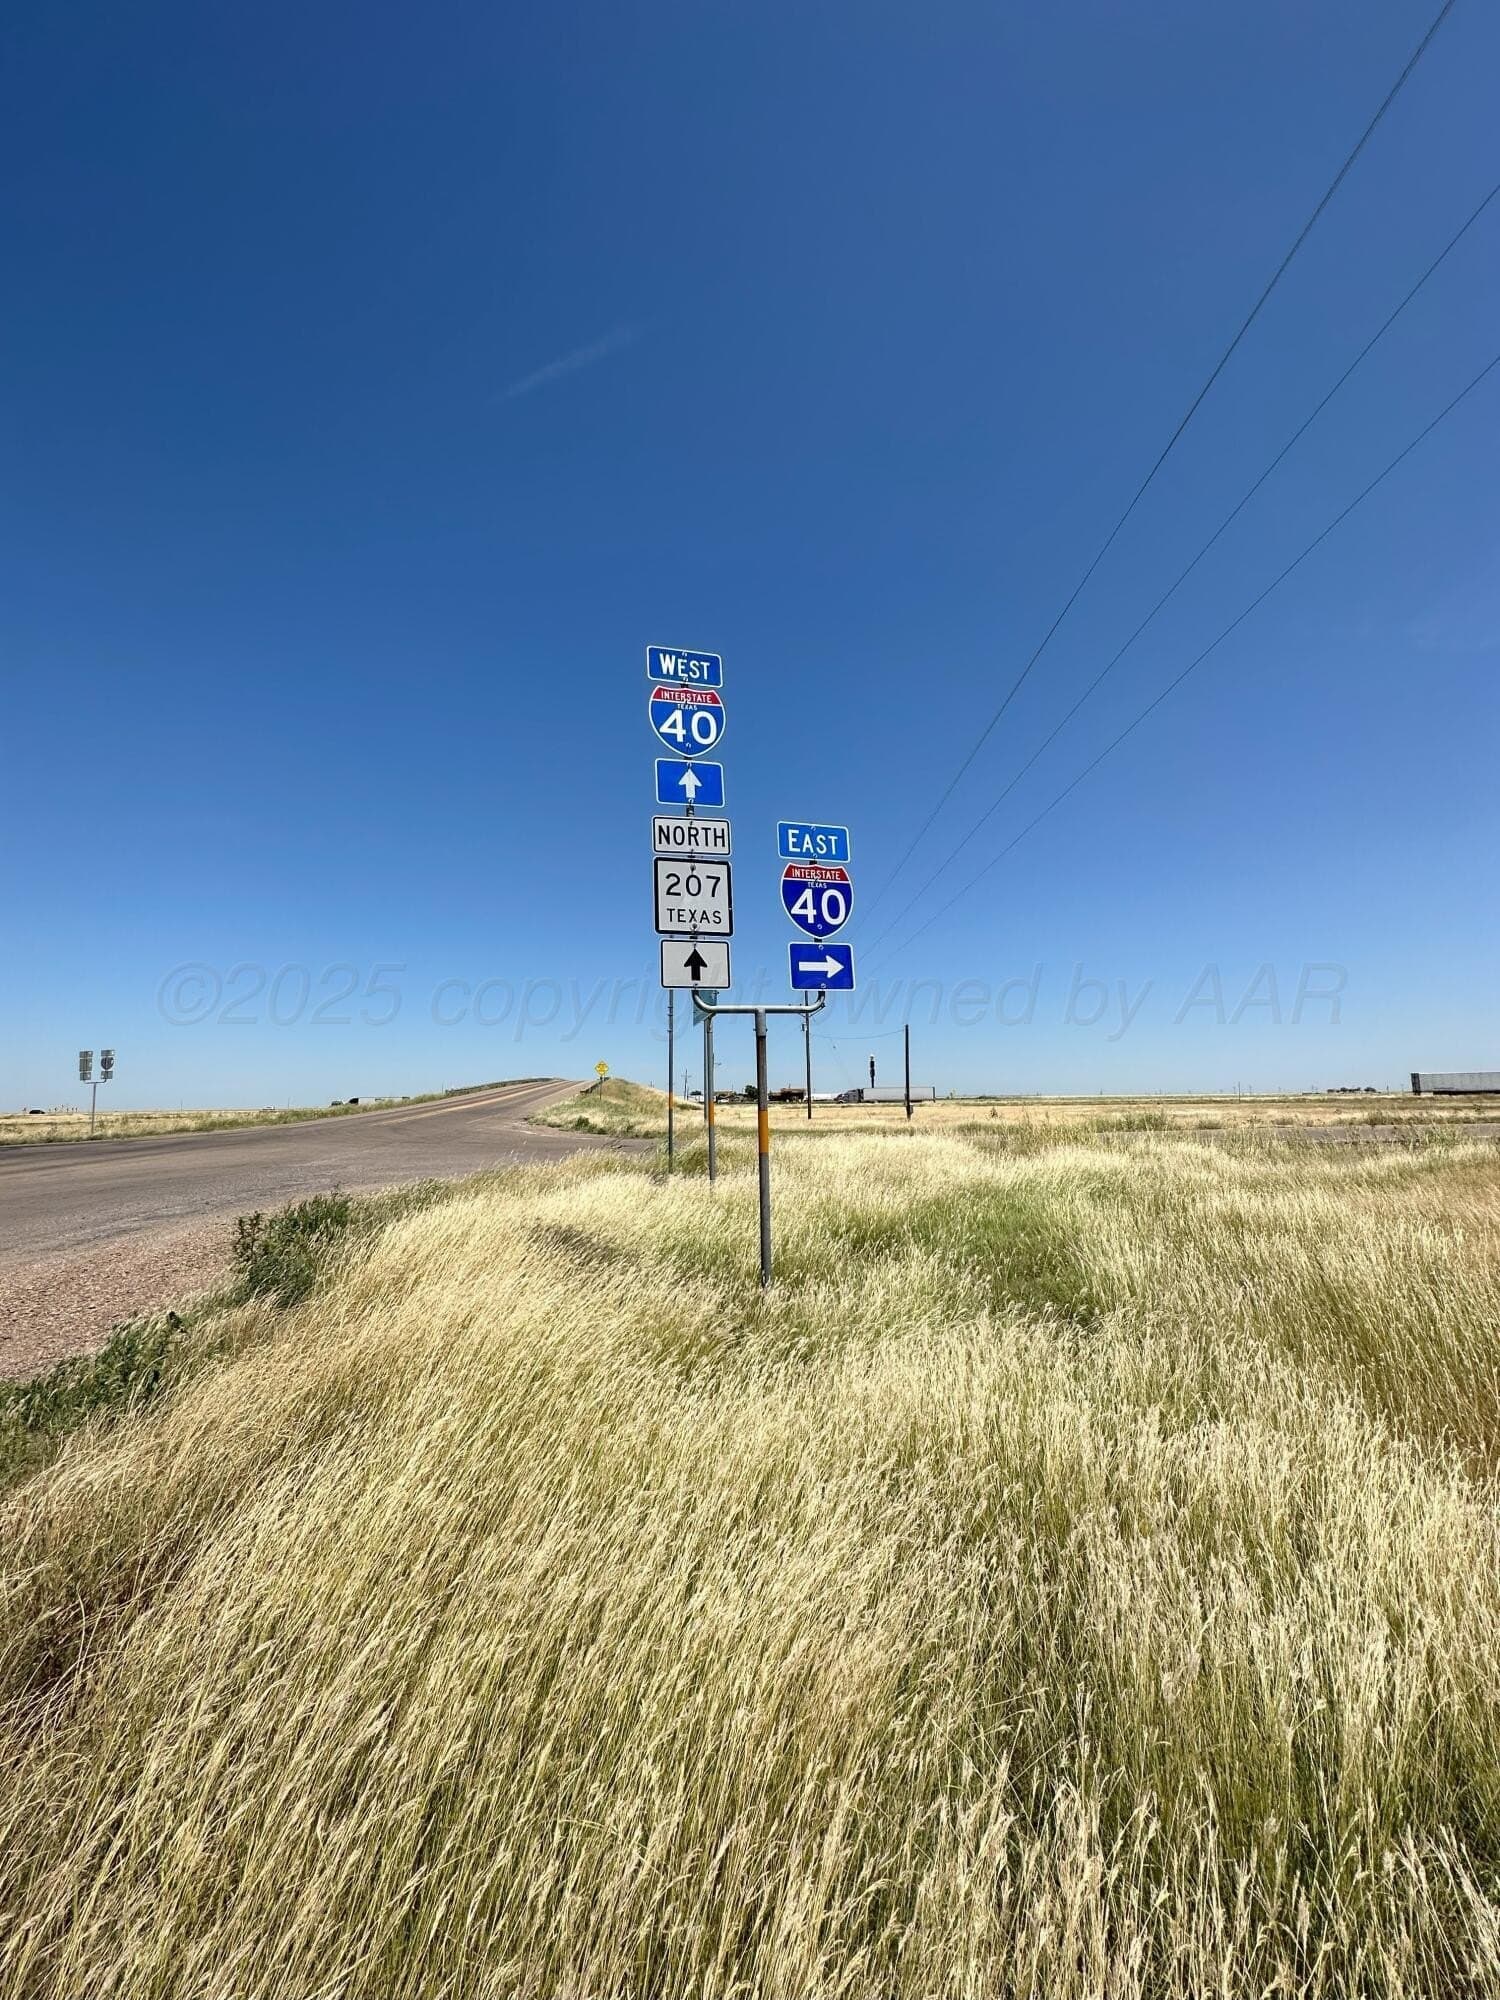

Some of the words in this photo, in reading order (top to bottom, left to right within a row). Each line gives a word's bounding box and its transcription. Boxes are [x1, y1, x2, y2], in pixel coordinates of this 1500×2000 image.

[659, 653, 711, 680] WEST
[661, 691, 712, 703] INTERSTATE
[659, 709, 718, 745] 40
[658, 825, 726, 848] NORTH
[788, 829, 838, 855] EAST
[665, 873, 721, 897] 207
[792, 868, 841, 880] INTERSTATE
[807, 881, 828, 889] TEXAS
[666, 908, 722, 925] TEXAS
[790, 888, 847, 926] 40
